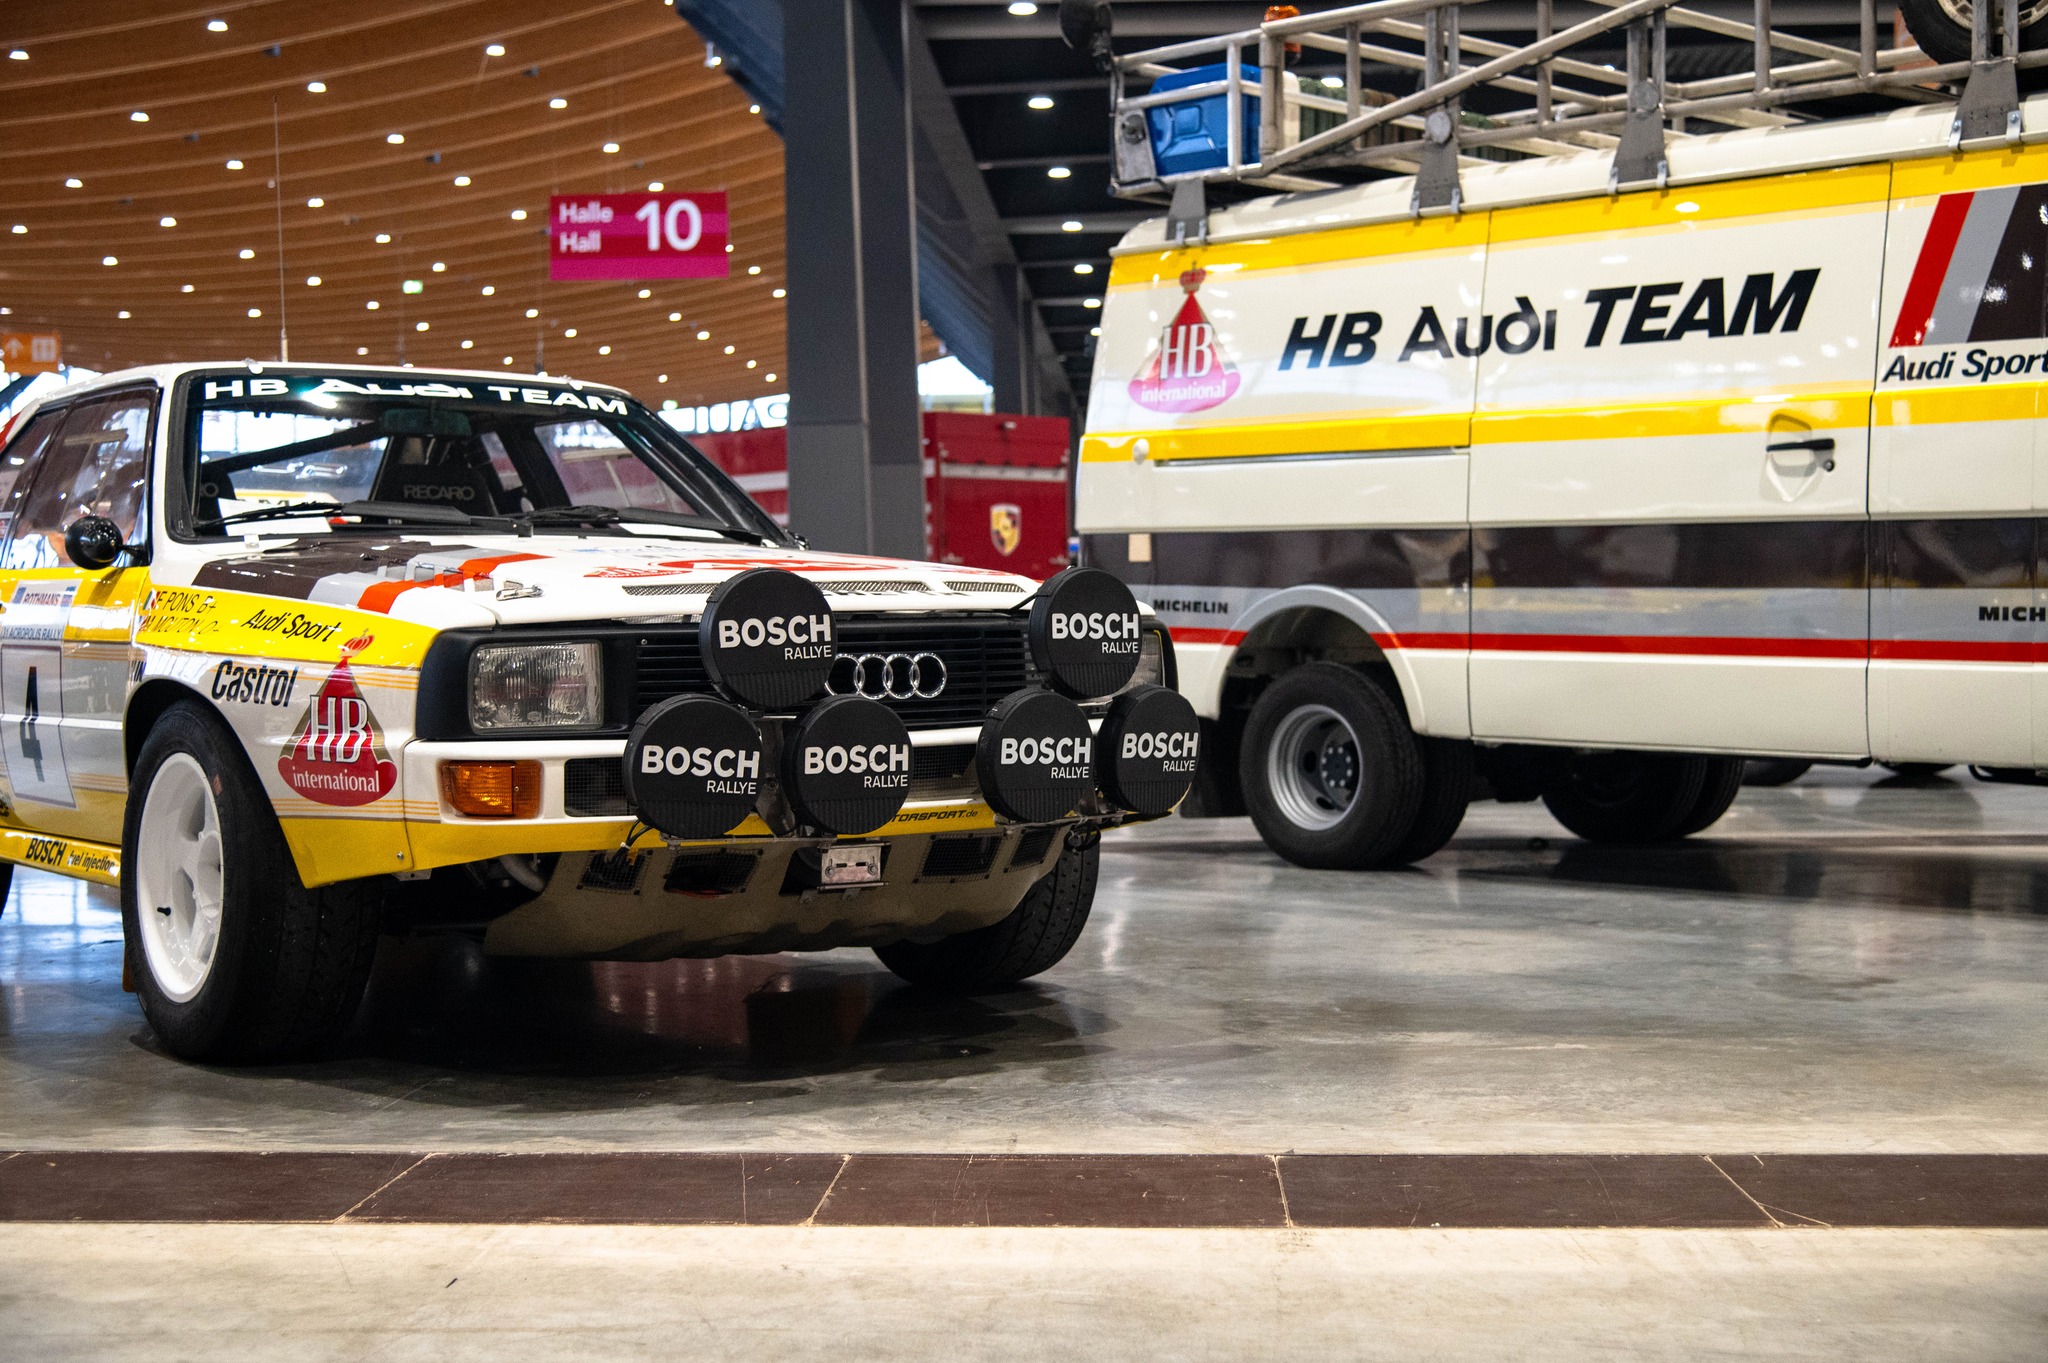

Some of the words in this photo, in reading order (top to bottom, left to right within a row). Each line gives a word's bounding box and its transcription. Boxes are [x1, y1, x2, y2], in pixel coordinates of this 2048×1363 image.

[559, 201, 614, 223] Halle
[635, 199, 702, 251] 10
[559, 230, 602, 253] Hall
[1278, 311, 1384, 371] HB
[1398, 296, 1558, 362] Audi
[1584, 268, 1821, 348] TEAM
[1160, 322, 1214, 380] HB
[1881, 350, 1957, 383] Audi
[205, 378, 289, 400] HB
[302, 379, 474, 399] Audi
[487, 385, 628, 416] TEAM
[1141, 380, 1227, 402] international
[403, 485, 475, 500] RECARO
[22, 593, 61, 606] ROTHMANS
[162, 591, 200, 612] PONS
[1153, 600, 1229, 614] MICHELIN
[240, 609, 291, 632] Audi
[281, 613, 342, 642] Sport
[1051, 612, 1139, 640] BOSCH
[1979, 605, 2046, 622] MICH
[42, 627, 62, 640] RALLY
[718, 614, 832, 648] BOSCH
[784, 645, 832, 660] RALLYE
[1101, 641, 1138, 654] RALLYE
[211, 659, 299, 708] Castrol
[19, 666, 45, 782] 4
[306, 694, 369, 764] HB
[1000, 737, 1092, 765] BOSCH
[1121, 732, 1199, 759] BOSCH
[641, 745, 760, 779] BOSCH
[804, 744, 909, 775] BOSCH
[1051, 766, 1090, 779] RALLYE
[1162, 760, 1196, 772] RALLYE
[292, 765, 380, 793] international
[706, 780, 757, 795] RALLYE
[863, 774, 909, 788] RALLYE
[25, 837, 67, 867] BOSCH
[82, 852, 116, 872] injection
